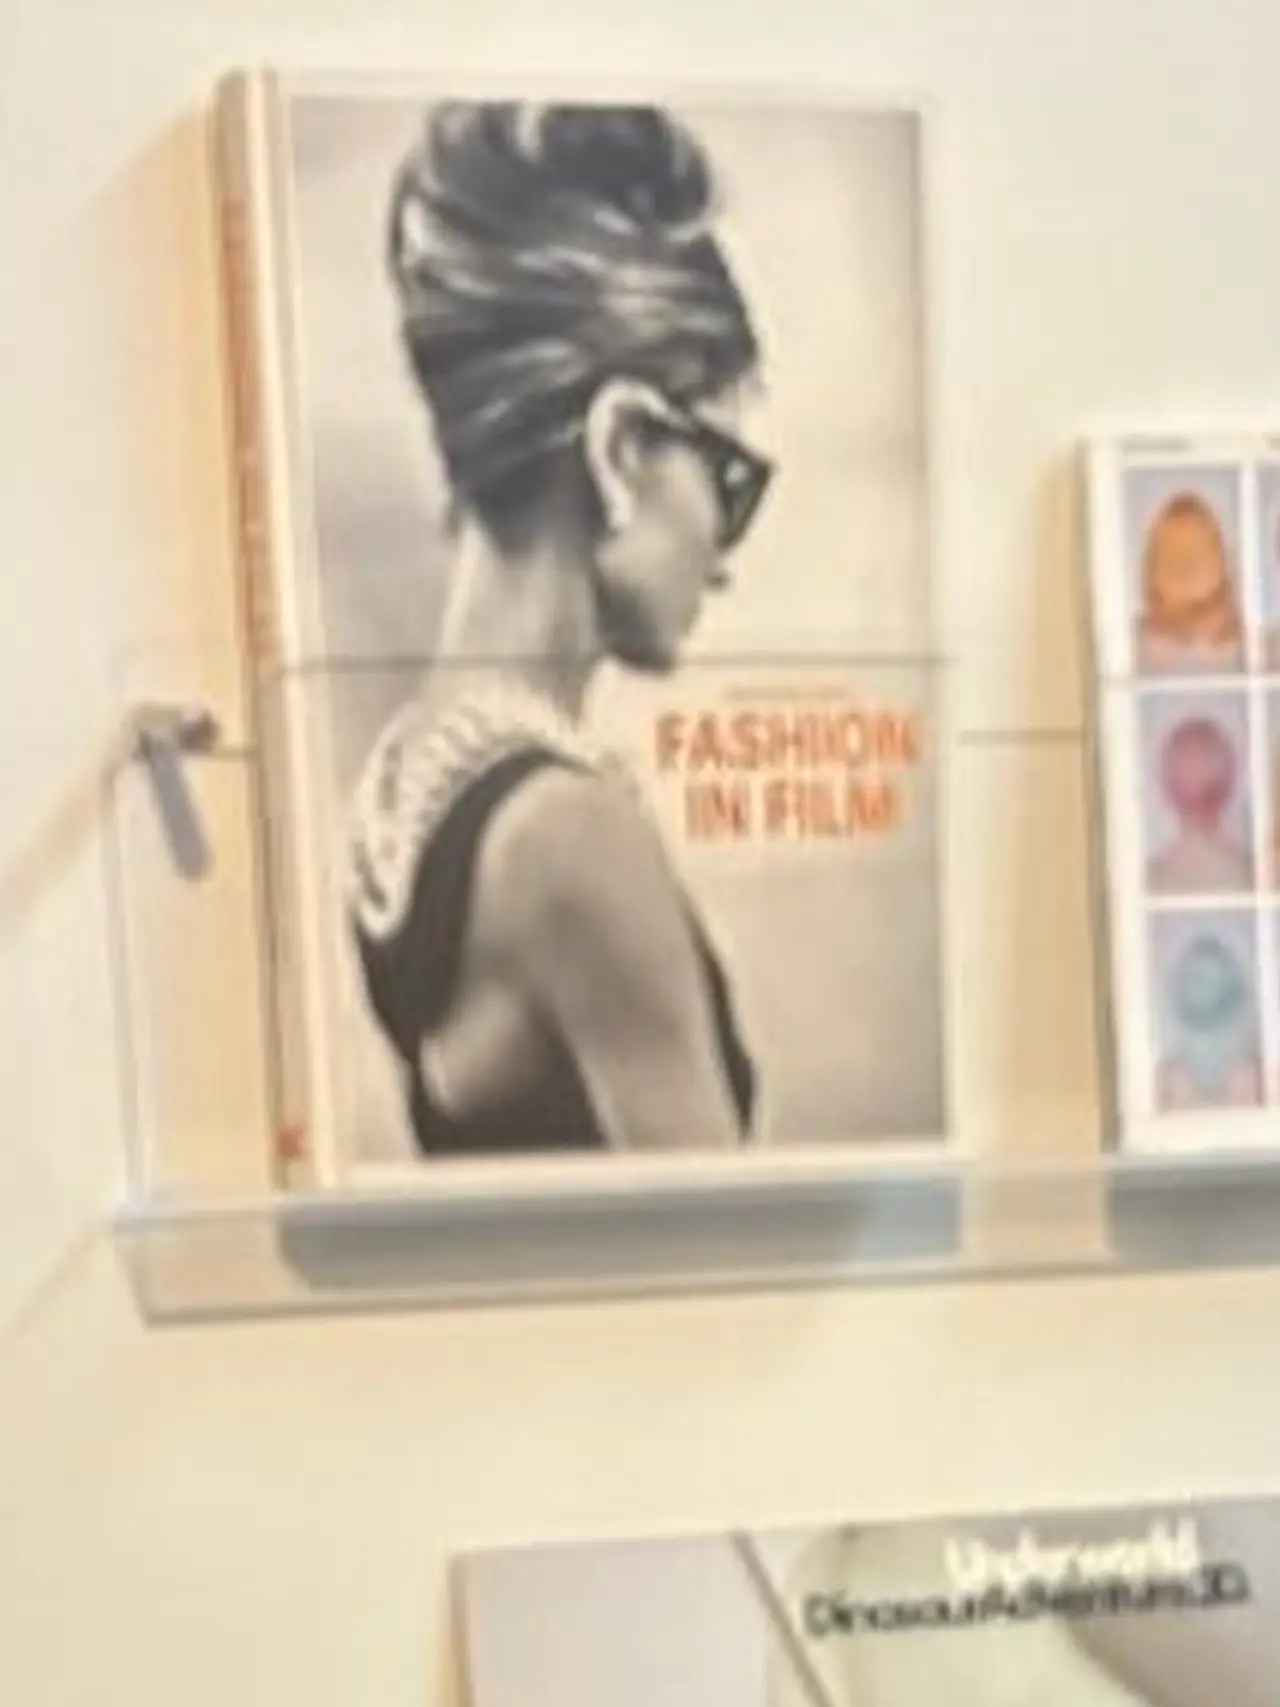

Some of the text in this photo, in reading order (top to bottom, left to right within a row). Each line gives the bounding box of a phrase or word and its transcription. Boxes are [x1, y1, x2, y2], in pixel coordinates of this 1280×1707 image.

[656, 708, 922, 770] FASHION
[684, 778, 901, 840] IN FILM
